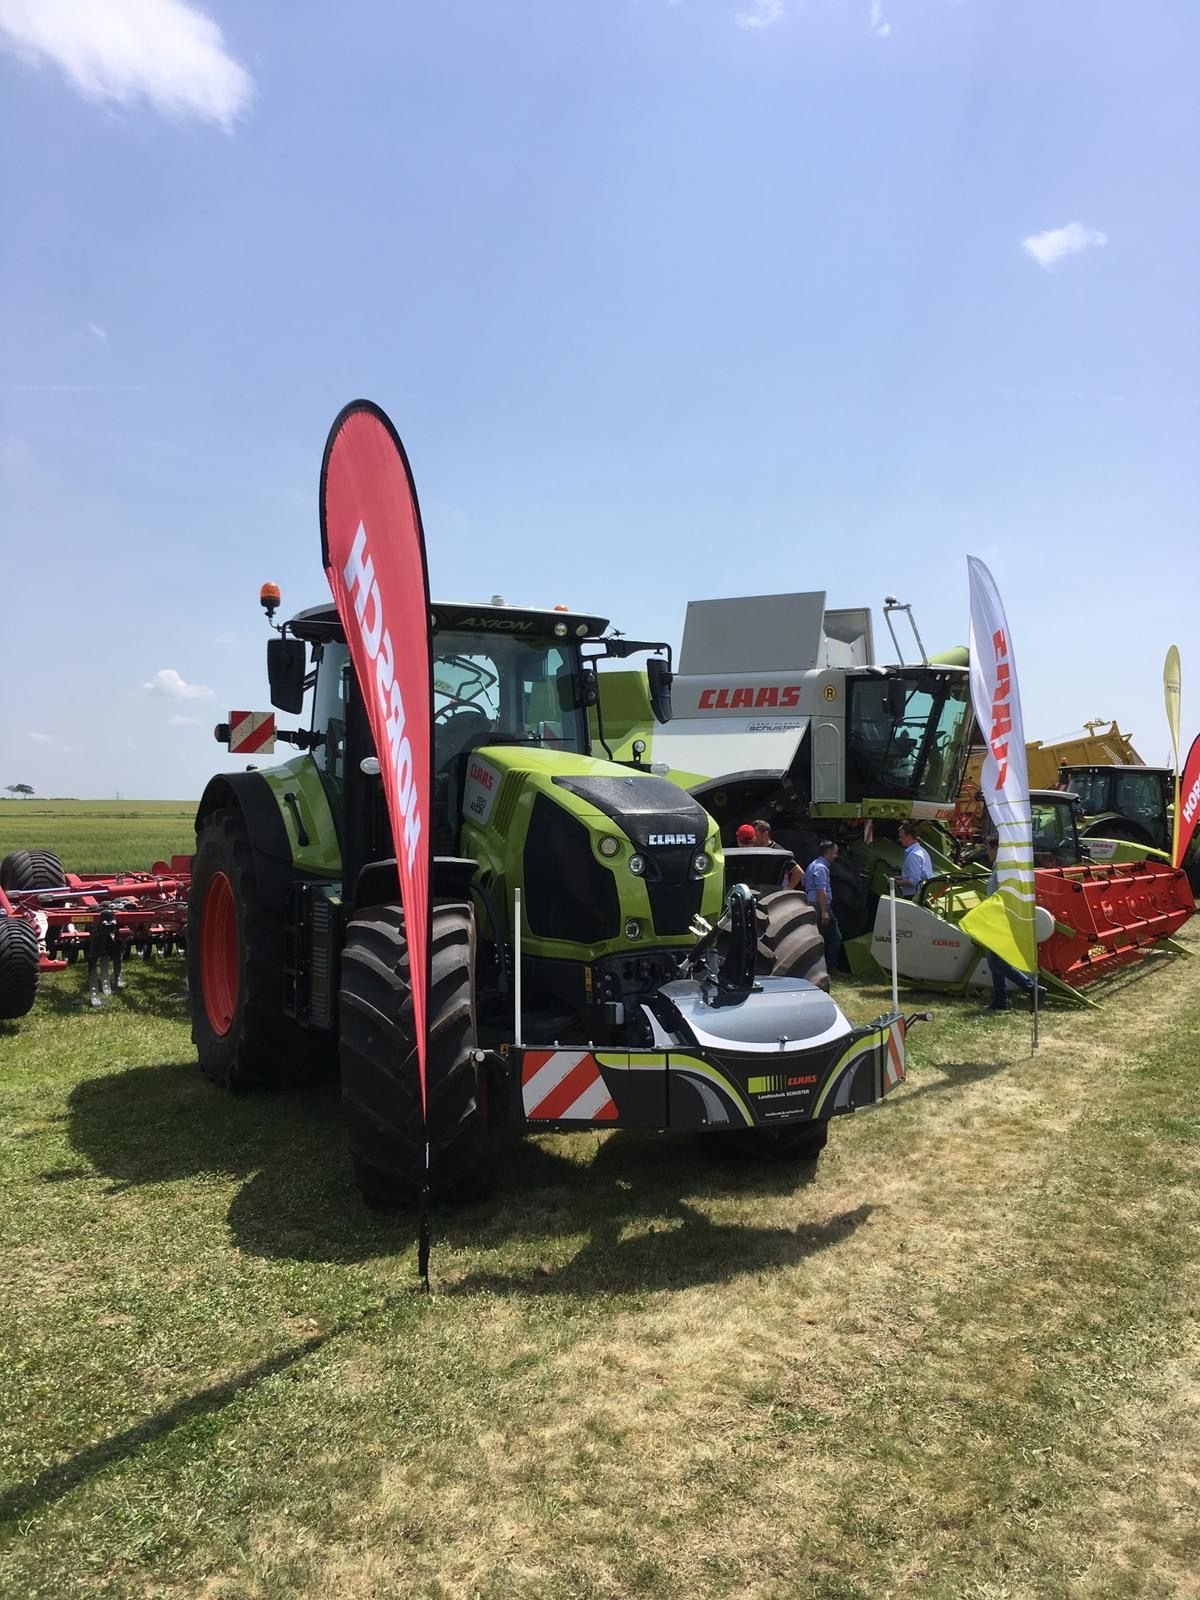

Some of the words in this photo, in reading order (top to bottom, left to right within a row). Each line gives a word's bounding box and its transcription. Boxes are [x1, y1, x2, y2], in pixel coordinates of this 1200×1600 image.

[458, 617, 533, 630] AXION
[698, 686, 802, 709] CLAAS
[470, 763, 494, 791] CLAAS
[1182, 773, 1200, 824] HOR
[648, 834, 696, 845] CLAAS
[932, 939, 960, 948] CLAAS
[788, 1075, 817, 1086] CLAAS
